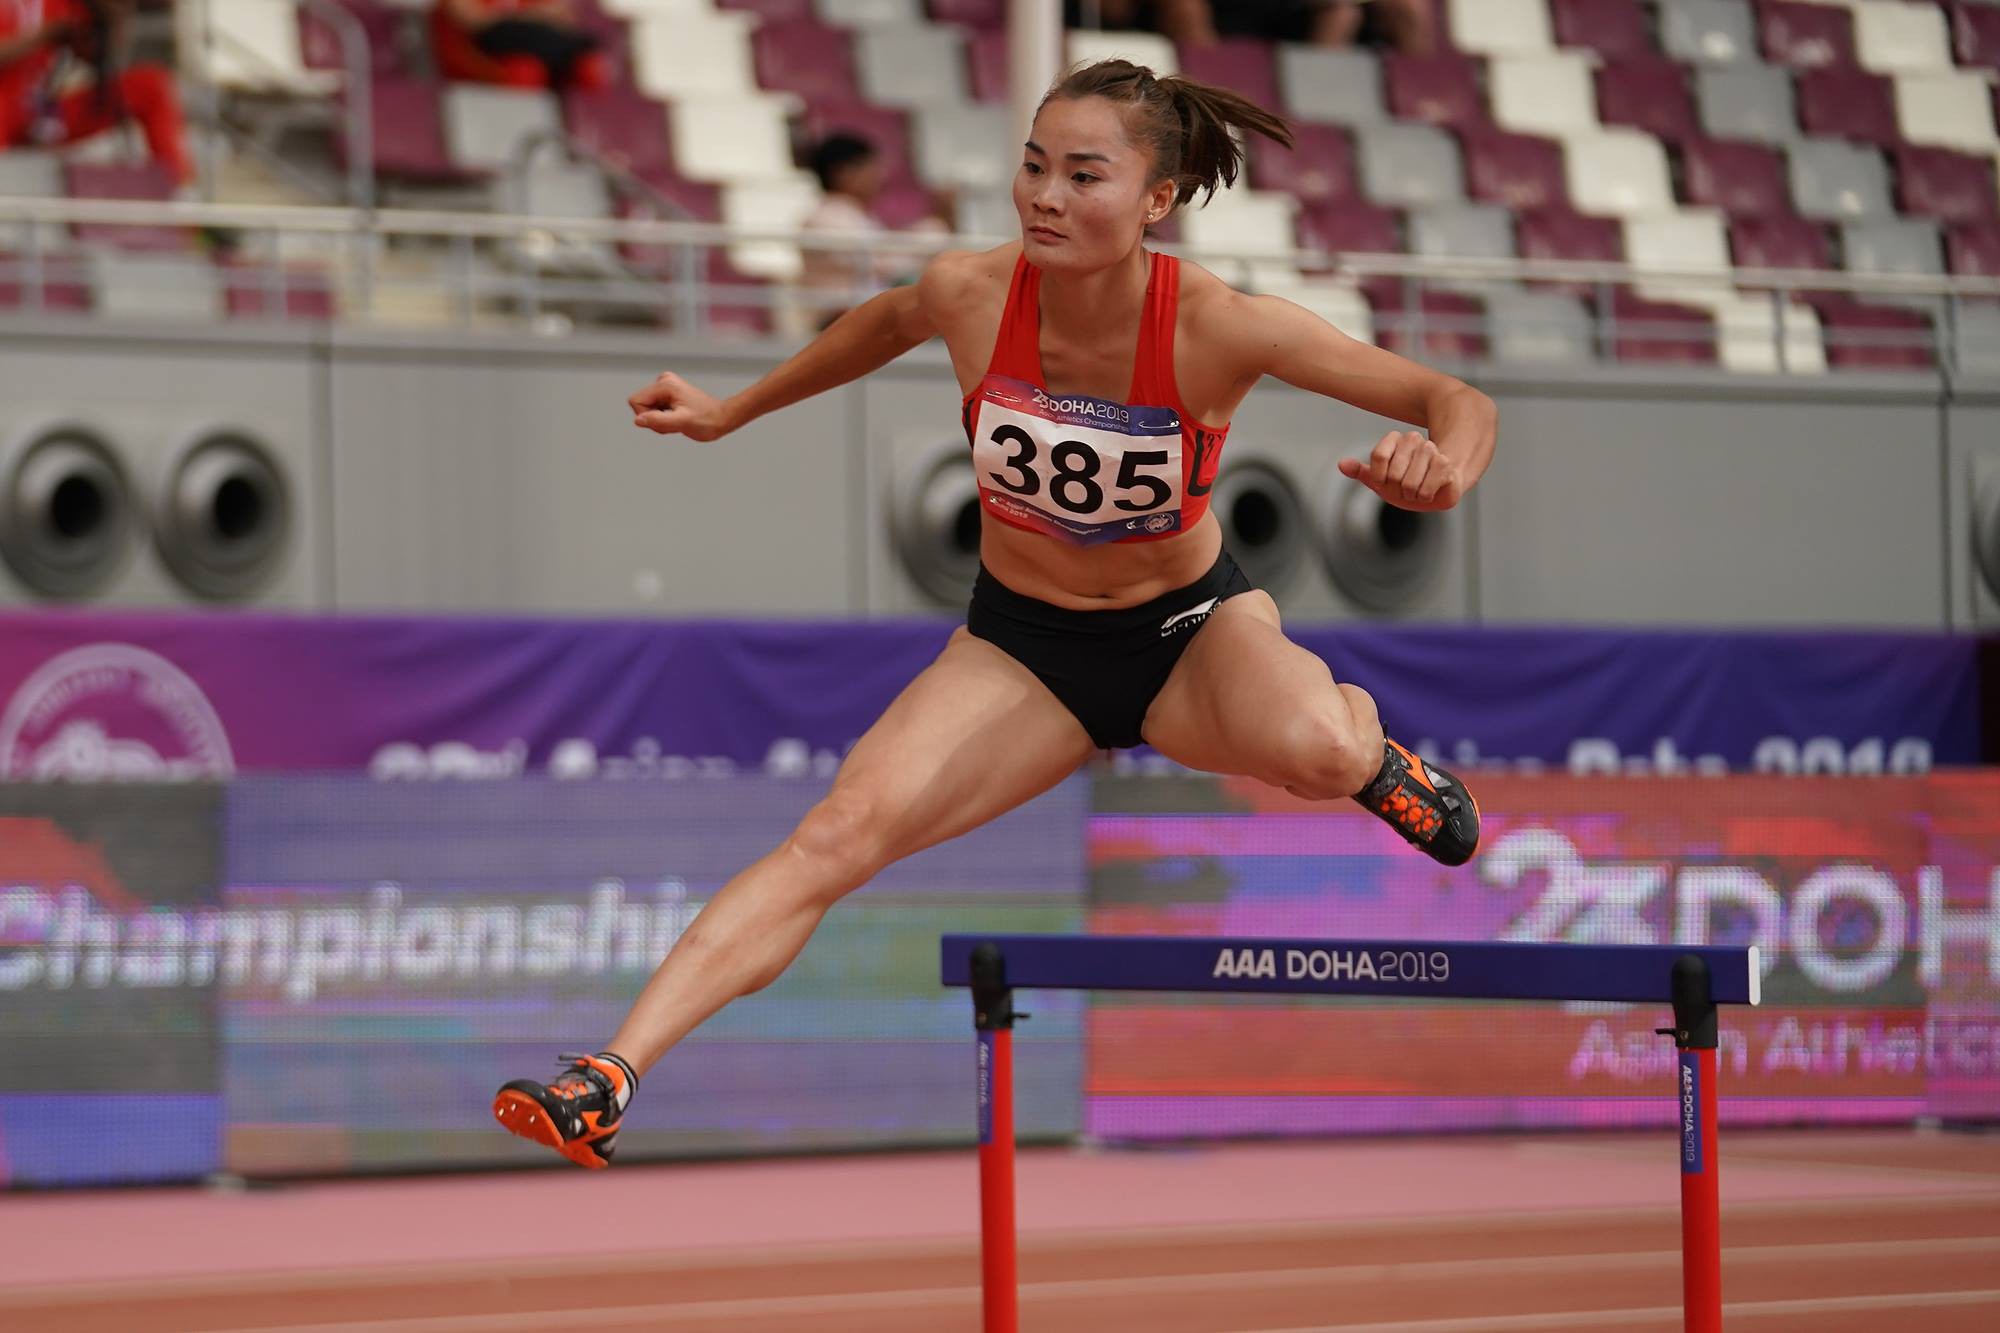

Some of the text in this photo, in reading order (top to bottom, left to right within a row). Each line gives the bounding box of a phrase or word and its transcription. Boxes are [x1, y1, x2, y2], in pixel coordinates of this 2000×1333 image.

[989, 424, 1172, 514] 385
[0, 880, 704, 1003] Championshi
[1213, 949, 1450, 982] AAA DOHA2019
